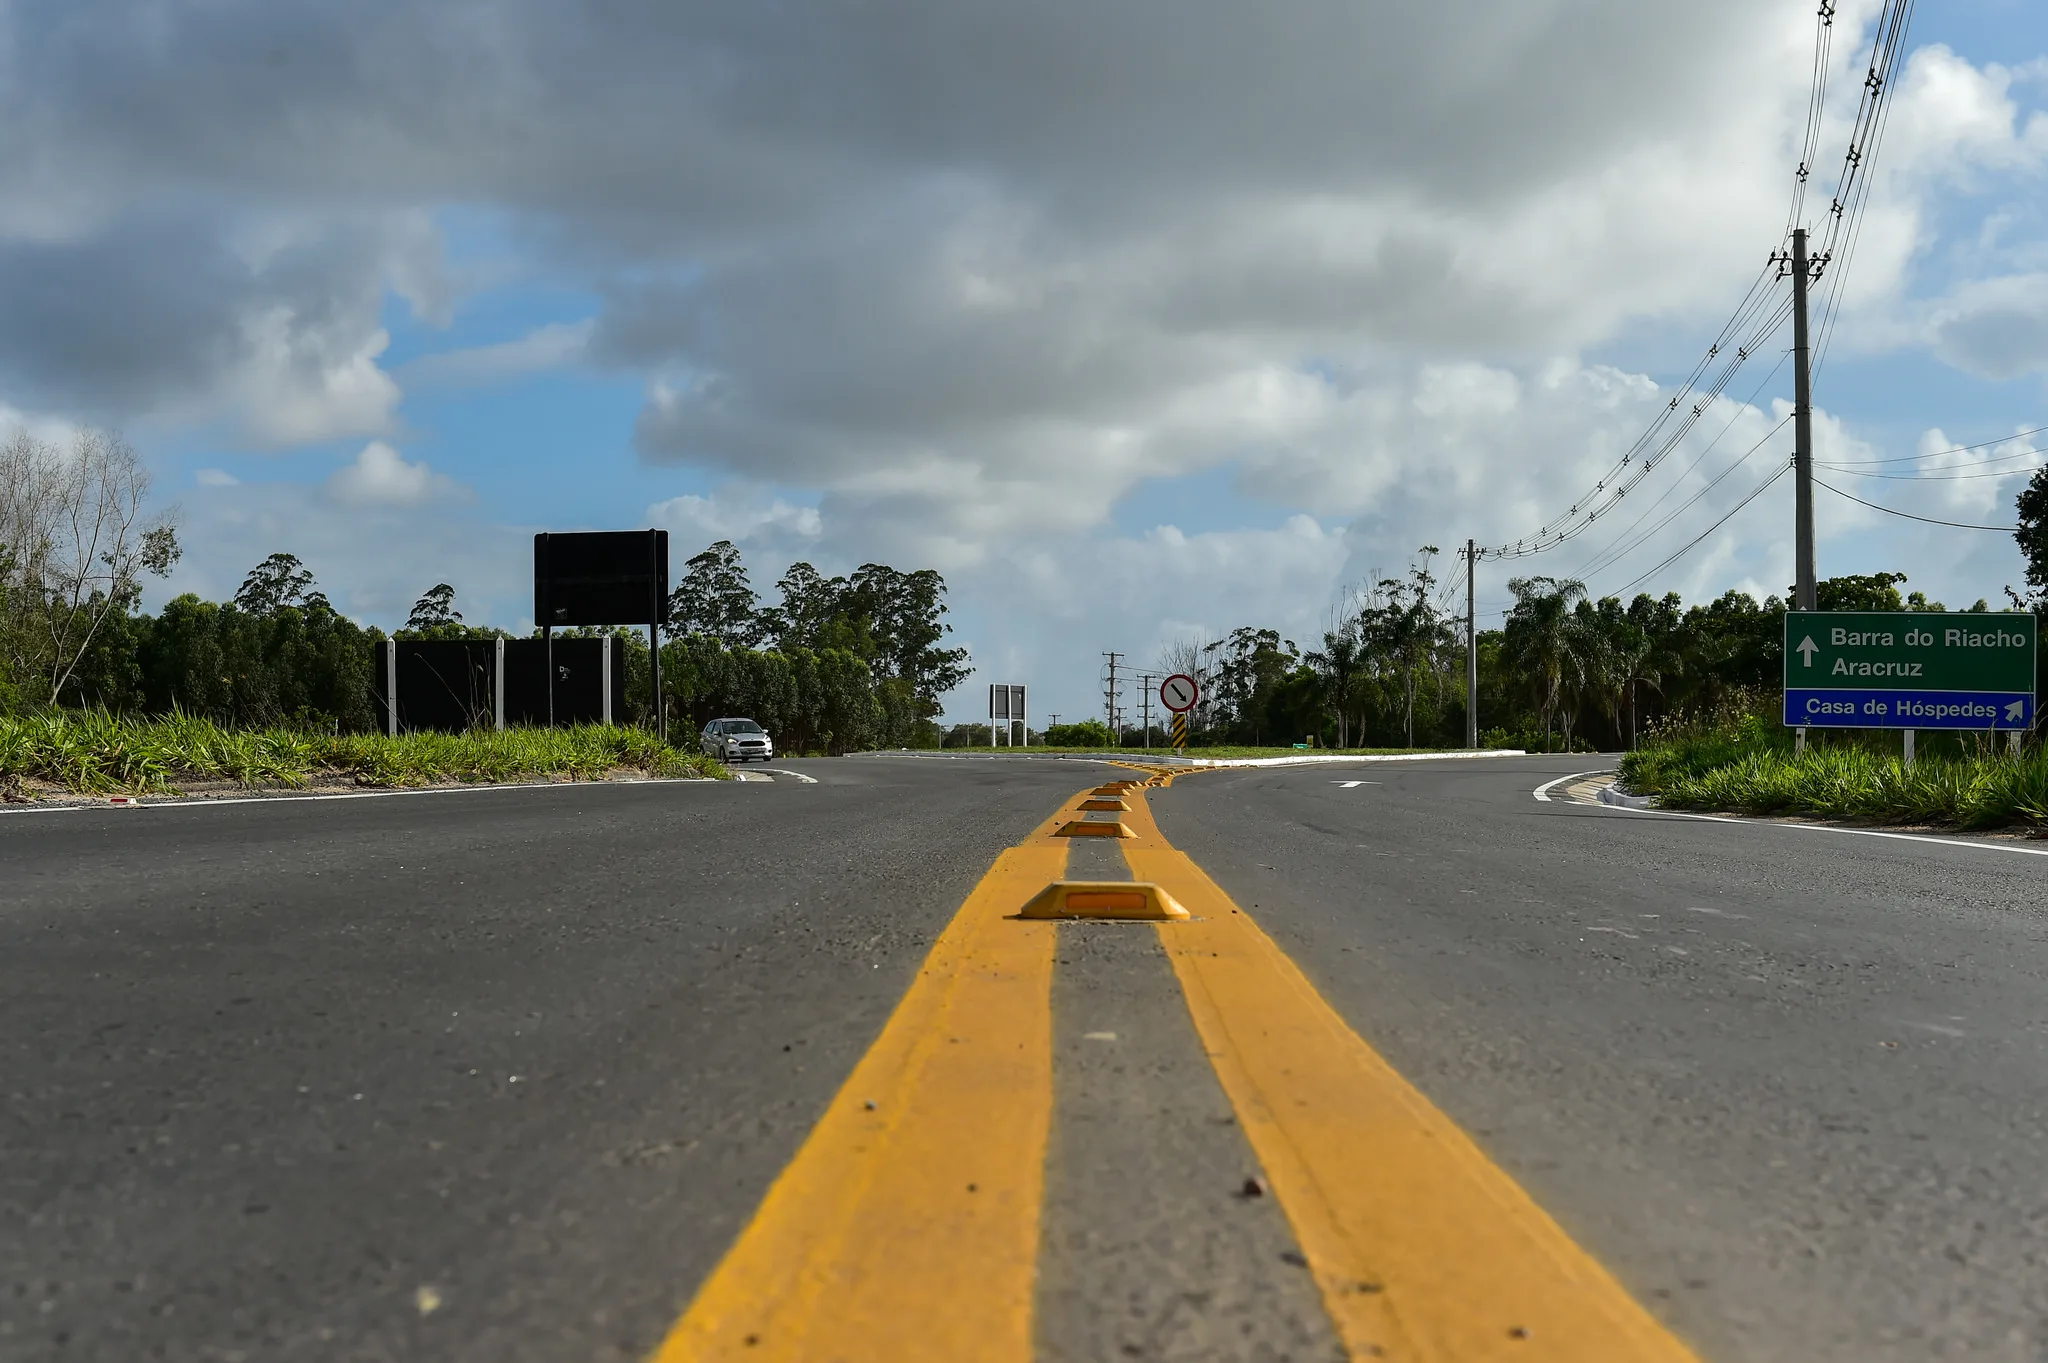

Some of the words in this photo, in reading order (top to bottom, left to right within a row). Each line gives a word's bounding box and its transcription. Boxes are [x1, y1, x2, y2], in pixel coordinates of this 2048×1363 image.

[1831, 627, 1894, 646] Barra
[1904, 628, 1934, 647] do
[1945, 628, 2026, 648] Riacho
[1831, 657, 1923, 677] Aracruz
[1806, 698, 1855, 714] Casa
[1863, 699, 1888, 715] de
[1896, 700, 1997, 720] Hóspedes
